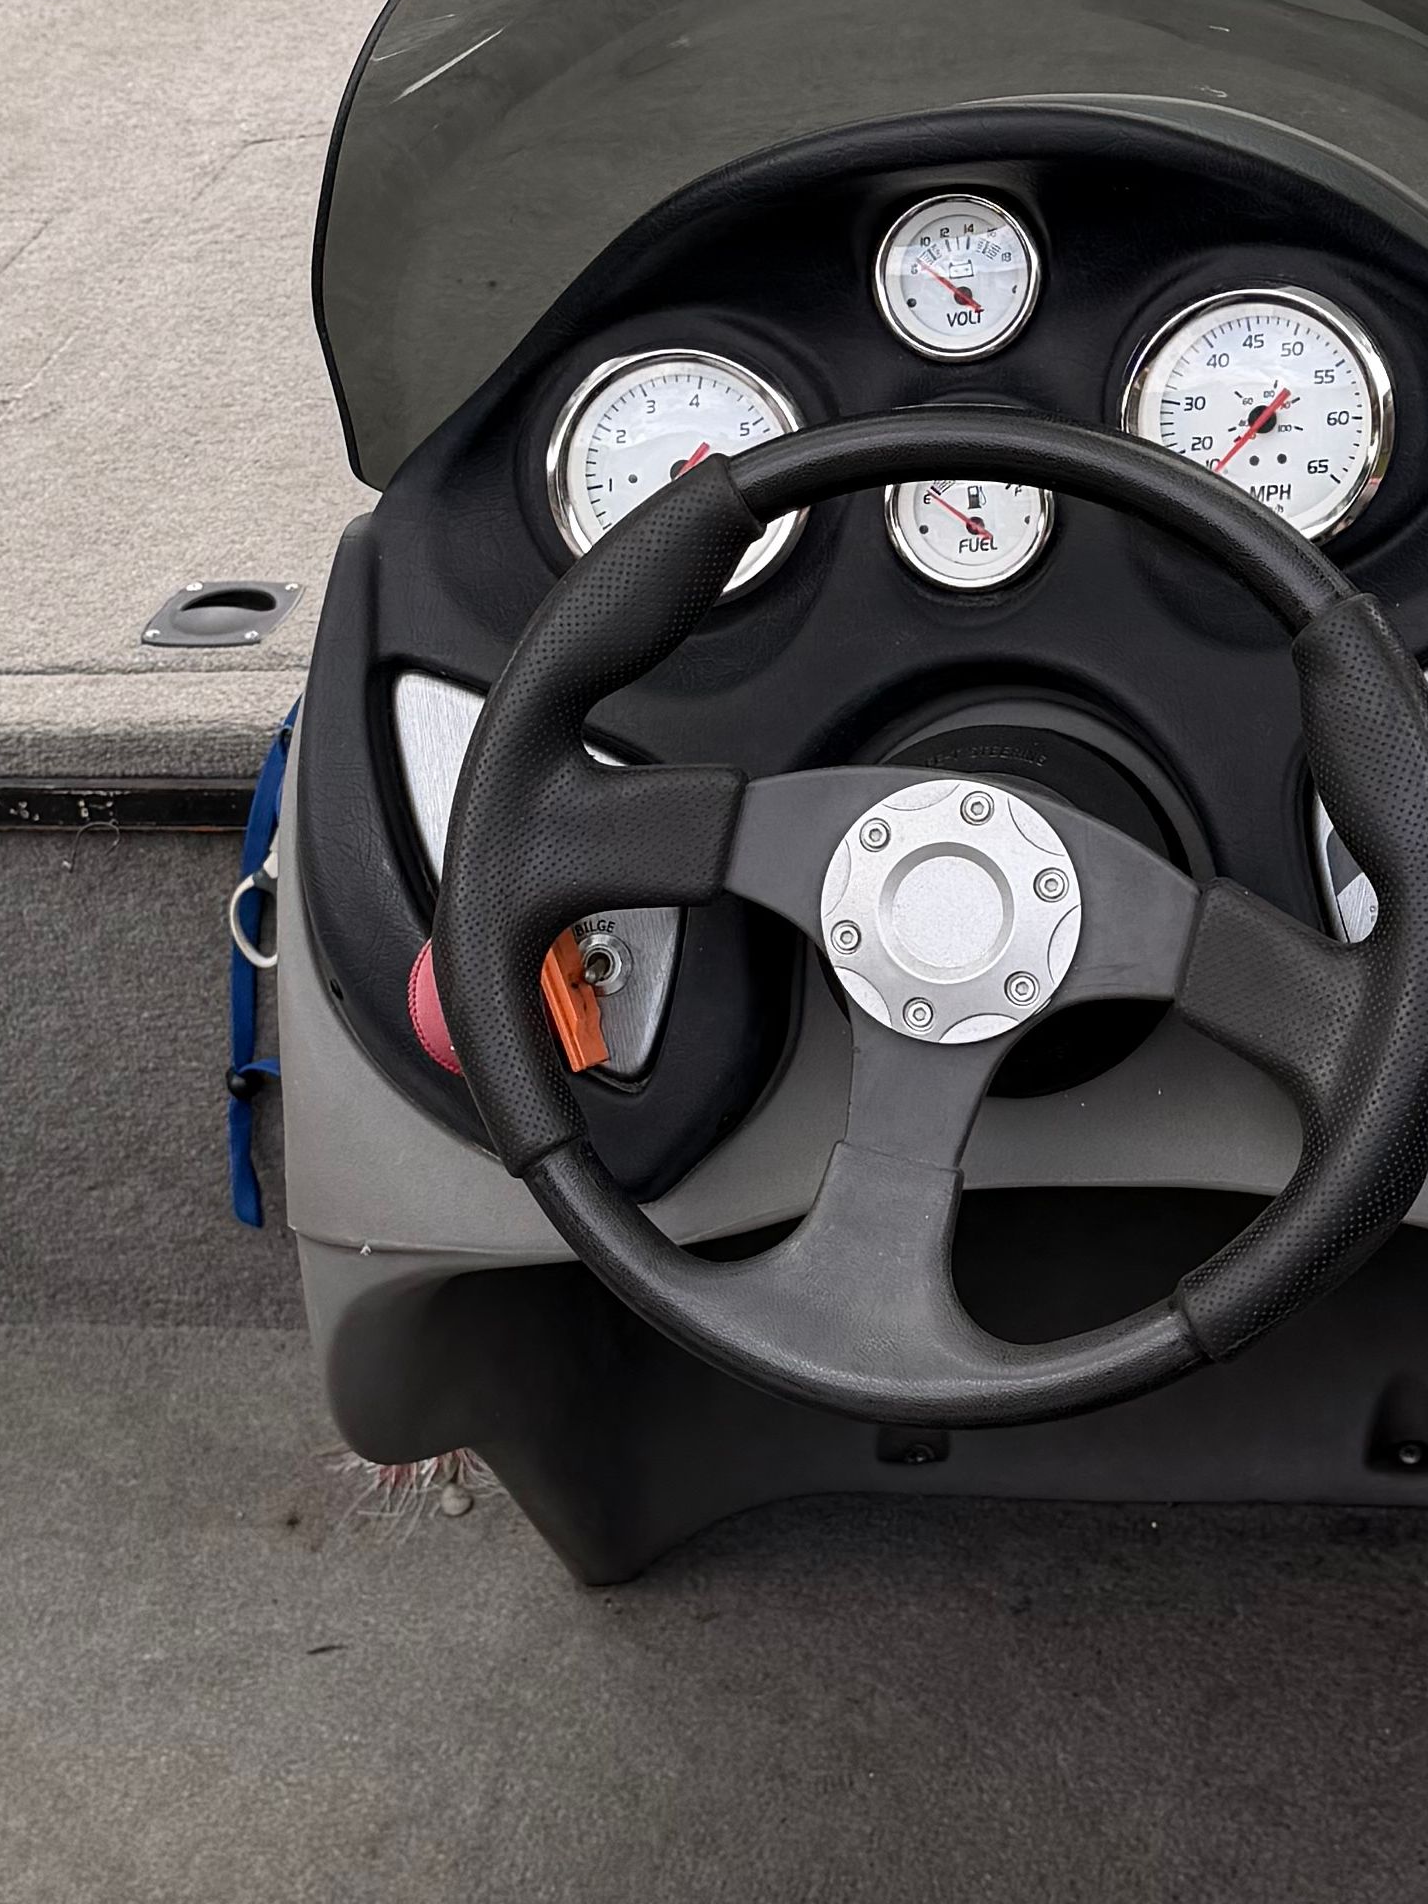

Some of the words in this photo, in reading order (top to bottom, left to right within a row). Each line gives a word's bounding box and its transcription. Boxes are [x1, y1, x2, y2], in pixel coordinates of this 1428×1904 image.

[940, 228, 949, 238] 12
[964, 224, 974, 234] 14
[920, 237, 931, 246] 10
[947, 307, 984, 327] VOLT
[1242, 333, 1264, 349] 45
[1280, 342, 1304, 356] 50
[1206, 353, 1229, 368] 40
[1314, 370, 1335, 384] 55
[646, 400, 656, 413] 3
[689, 394, 700, 408] 4
[1183, 397, 1205, 411] 30
[1327, 411, 1349, 425] 60
[616, 430, 626, 443] 2
[740, 423, 749, 436] 5
[1191, 436, 1213, 451] 20
[1308, 460, 1328, 474] 65
[609, 478, 613, 492] 1
[1250, 484, 1291, 503] MPH
[959, 538, 997, 553] FUEL
[574, 919, 615, 937] BILGE
